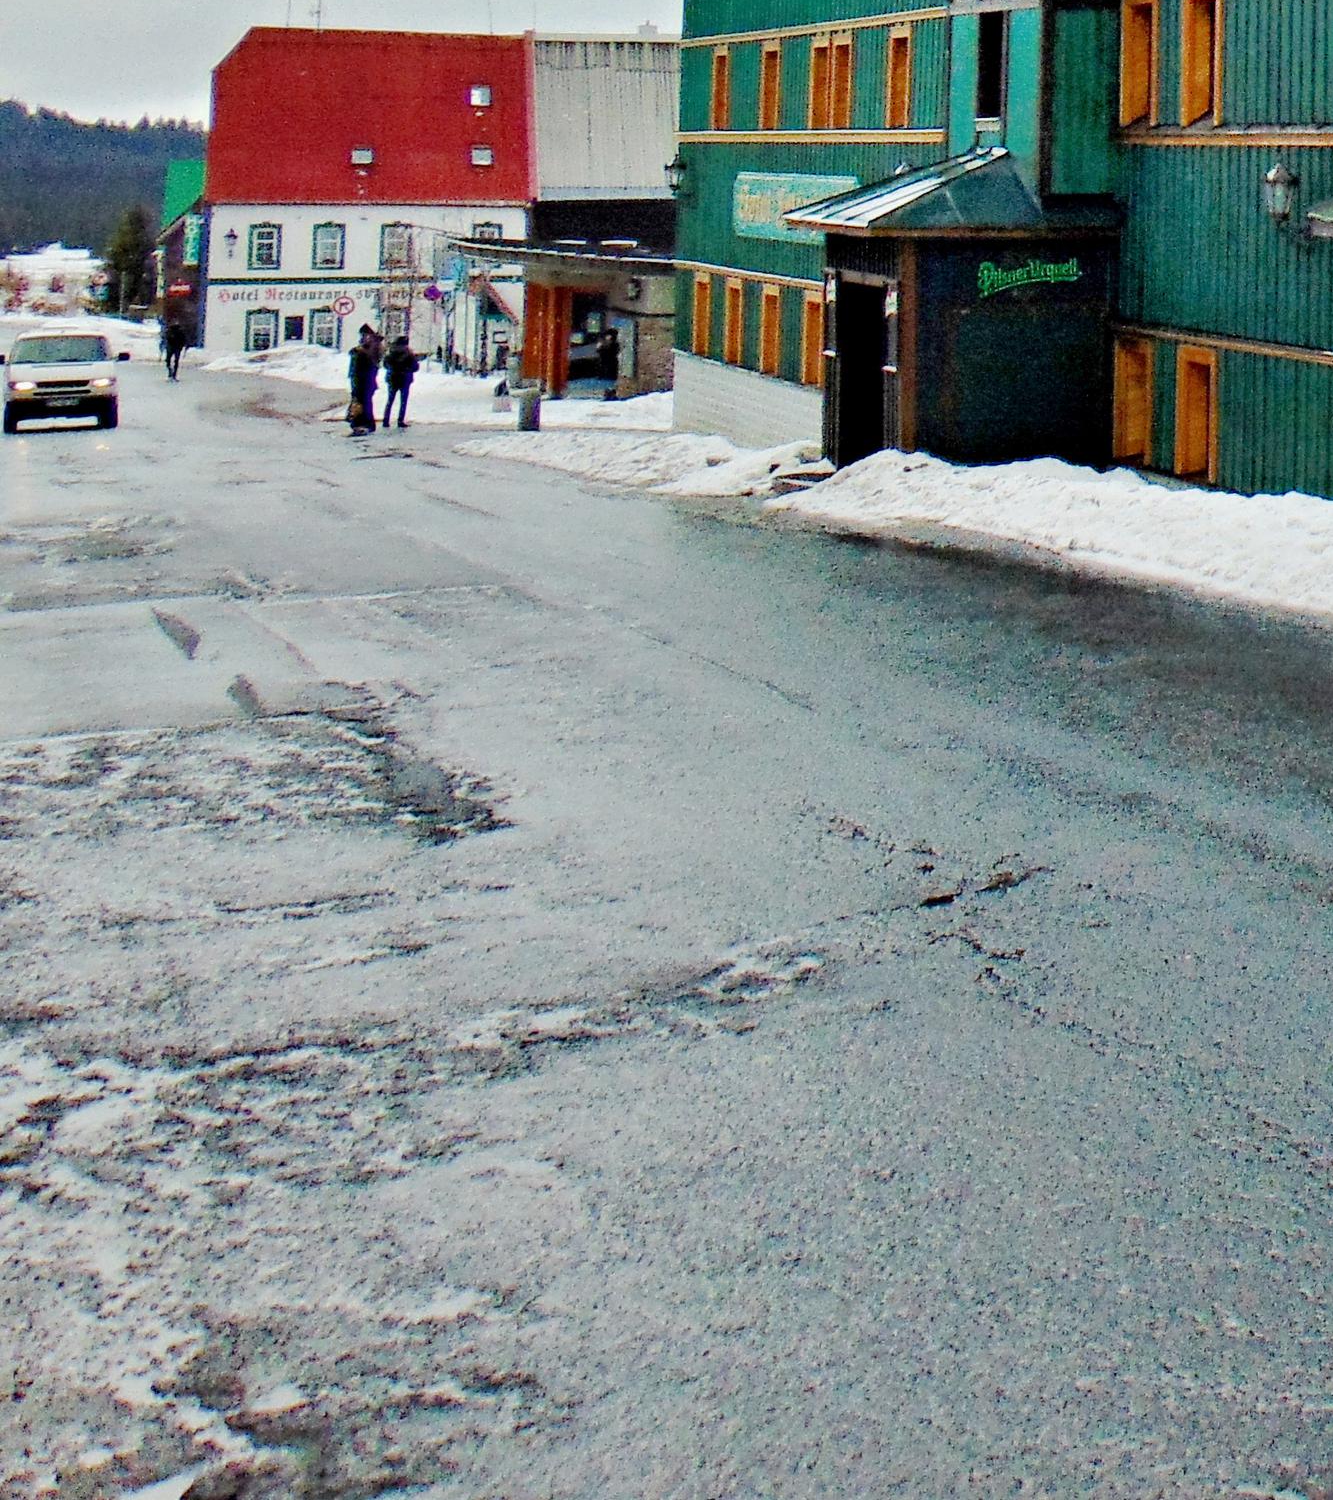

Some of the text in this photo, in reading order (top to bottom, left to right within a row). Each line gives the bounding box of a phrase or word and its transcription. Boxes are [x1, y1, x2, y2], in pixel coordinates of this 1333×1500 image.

[978, 257, 1079, 297] Pilsner Urquell
[217, 287, 259, 303] Hotel
[265, 286, 348, 301] Restaurant
